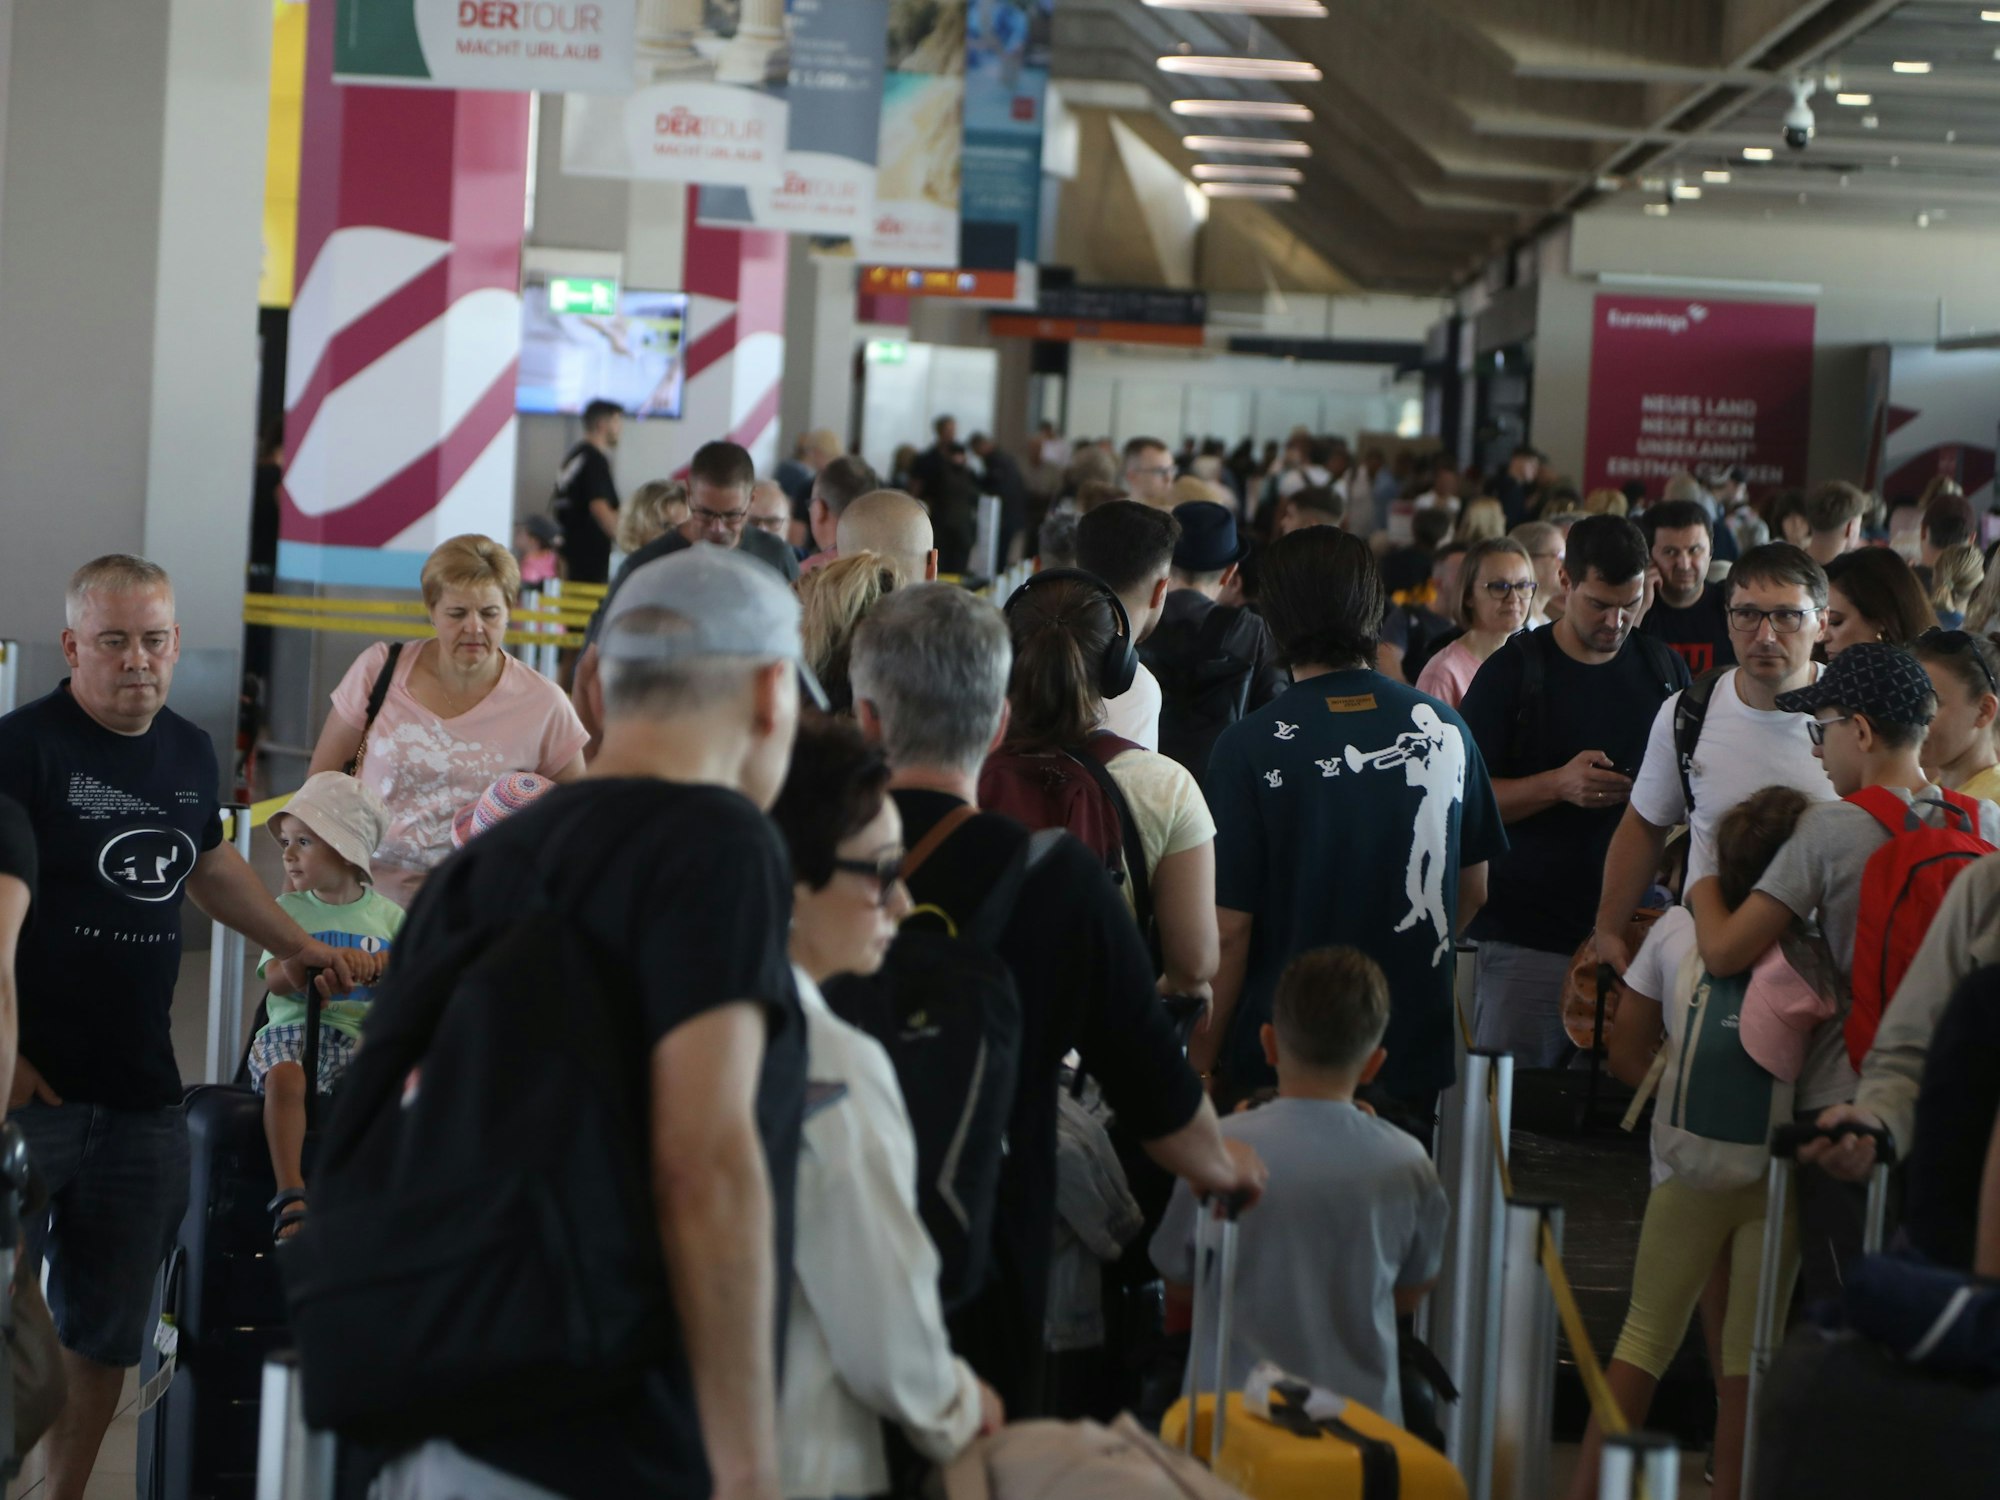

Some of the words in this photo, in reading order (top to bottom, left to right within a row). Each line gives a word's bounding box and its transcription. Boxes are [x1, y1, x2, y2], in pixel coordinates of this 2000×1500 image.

[457, 0, 602, 33] DERTOUR
[455, 39, 521, 56] MACHT
[525, 42, 602, 60] URLAUB
[655, 112, 764, 140] DERTOUR
[1607, 308, 1689, 334] Eurowings
[1641, 393, 1701, 415] NEUES
[1705, 396, 1757, 419] LAND
[1641, 416, 1689, 437] NEUE
[1693, 418, 1756, 440] ECKEN
[74, 925, 101, 938] TOM
[114, 931, 161, 944] TAILOR
